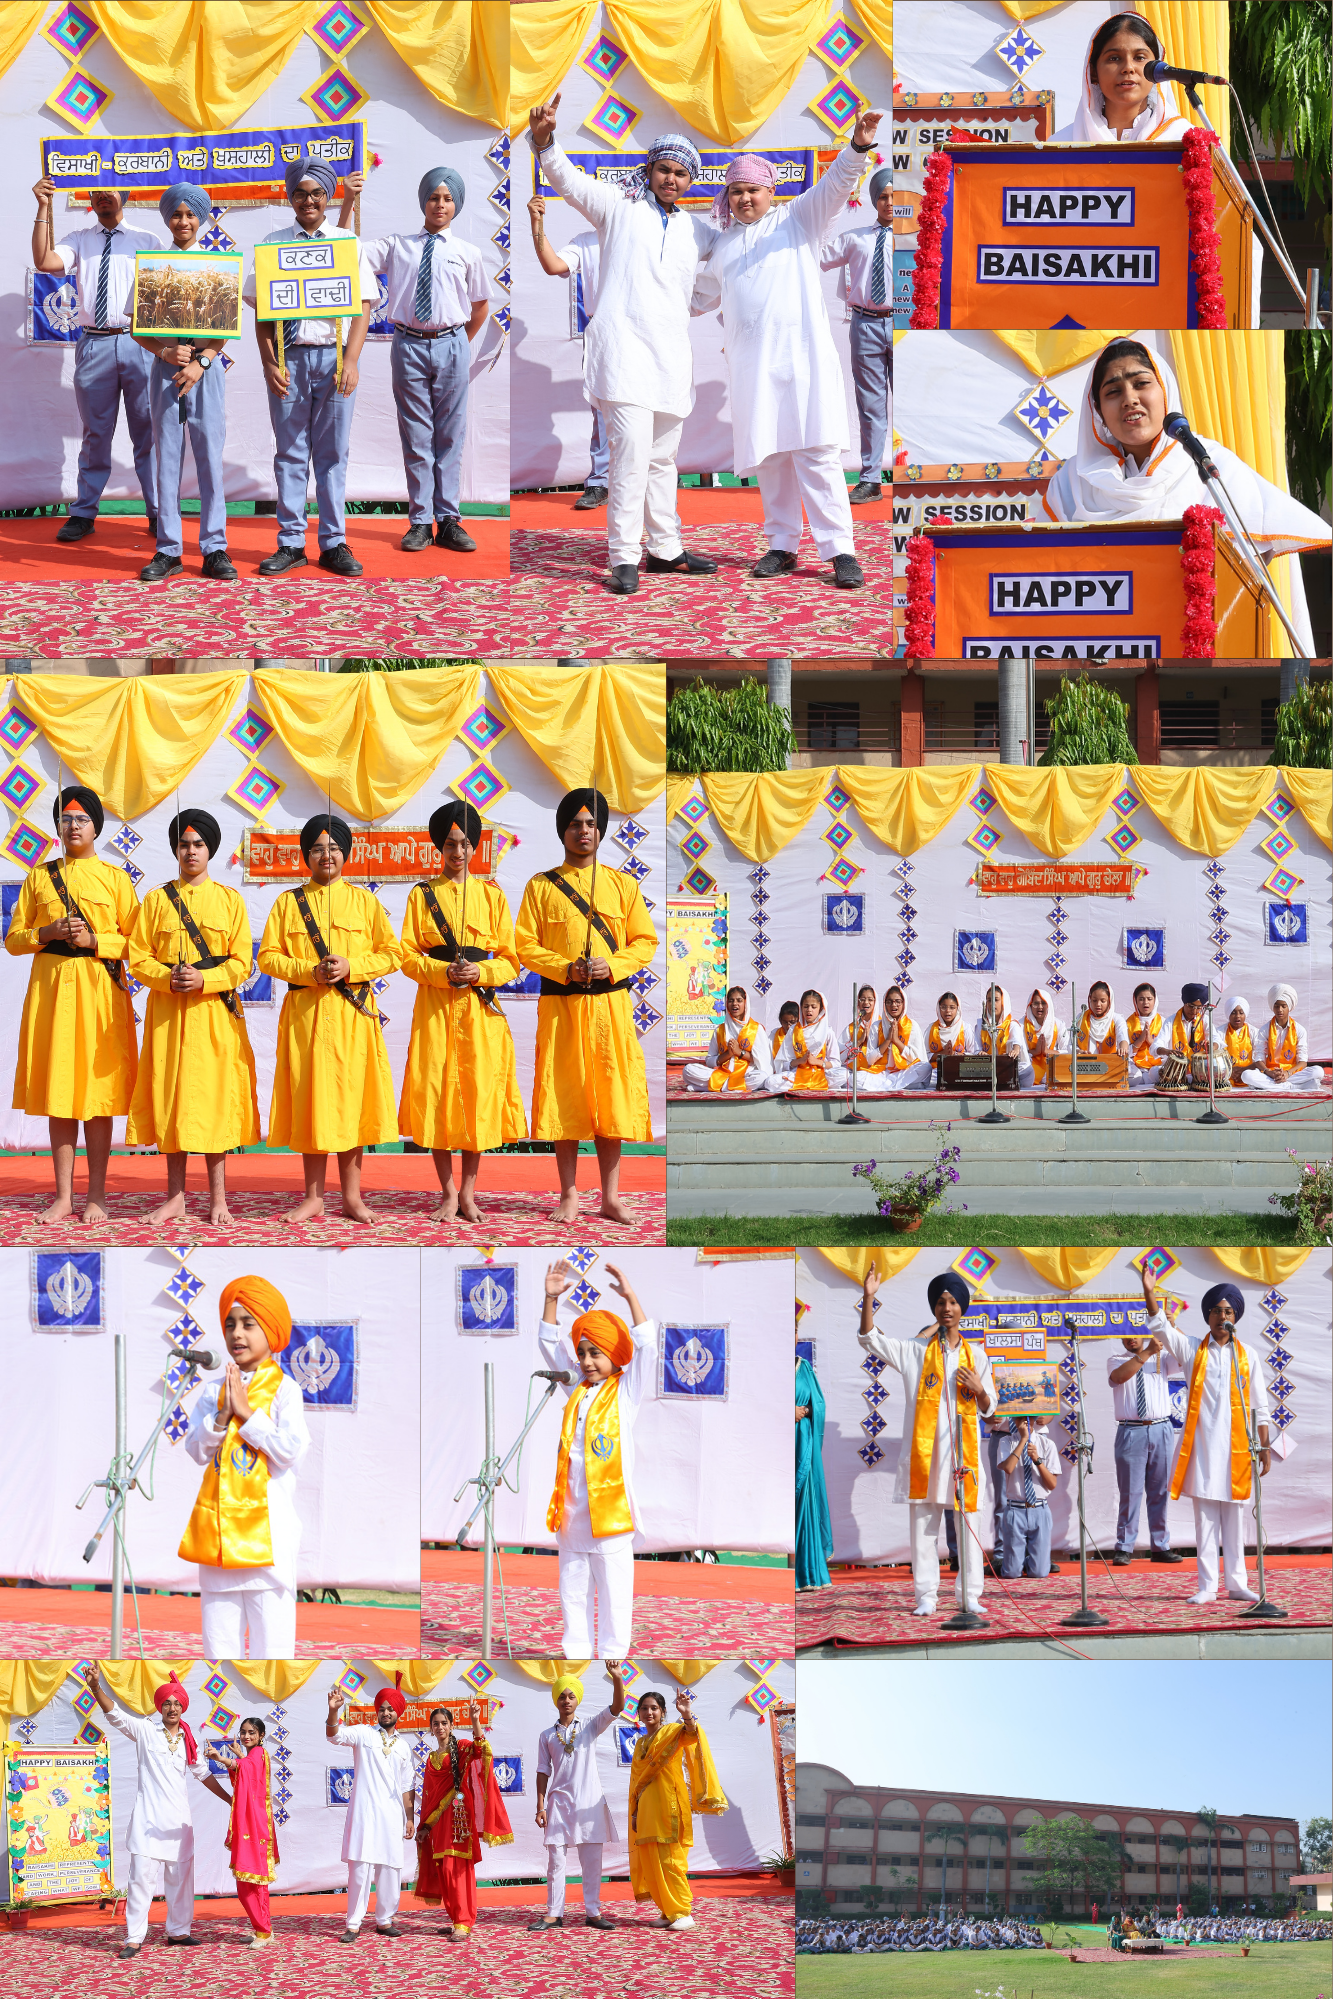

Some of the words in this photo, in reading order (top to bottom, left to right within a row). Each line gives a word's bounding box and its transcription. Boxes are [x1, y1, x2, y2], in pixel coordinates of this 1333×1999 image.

[51, 153, 99, 173] ਵਿਸਾਖੀ
[116, 150, 171, 172] ਕੁਰਬਾਨੀ
[180, 148, 206, 168] ਅਤੇ
[282, 145, 300, 161] ਦਾ
[894, 207, 911, 216] will
[1009, 194, 1127, 220] HAPPY
[283, 248, 329, 266] ਕਣਕ
[983, 252, 1152, 279] BAISAKHI
[274, 284, 295, 306] ਦੀ
[308, 281, 347, 303] ਵਾਢੀ
[996, 579, 1124, 608] HAPPY
[388, 836, 418, 864] ਆਪੇ
[1103, 867, 1124, 886] ਚੇਲਾ
[677, 910, 716, 918] BAISAKHI
[987, 1335, 1022, 1346] ਖਾਲਸਾ
